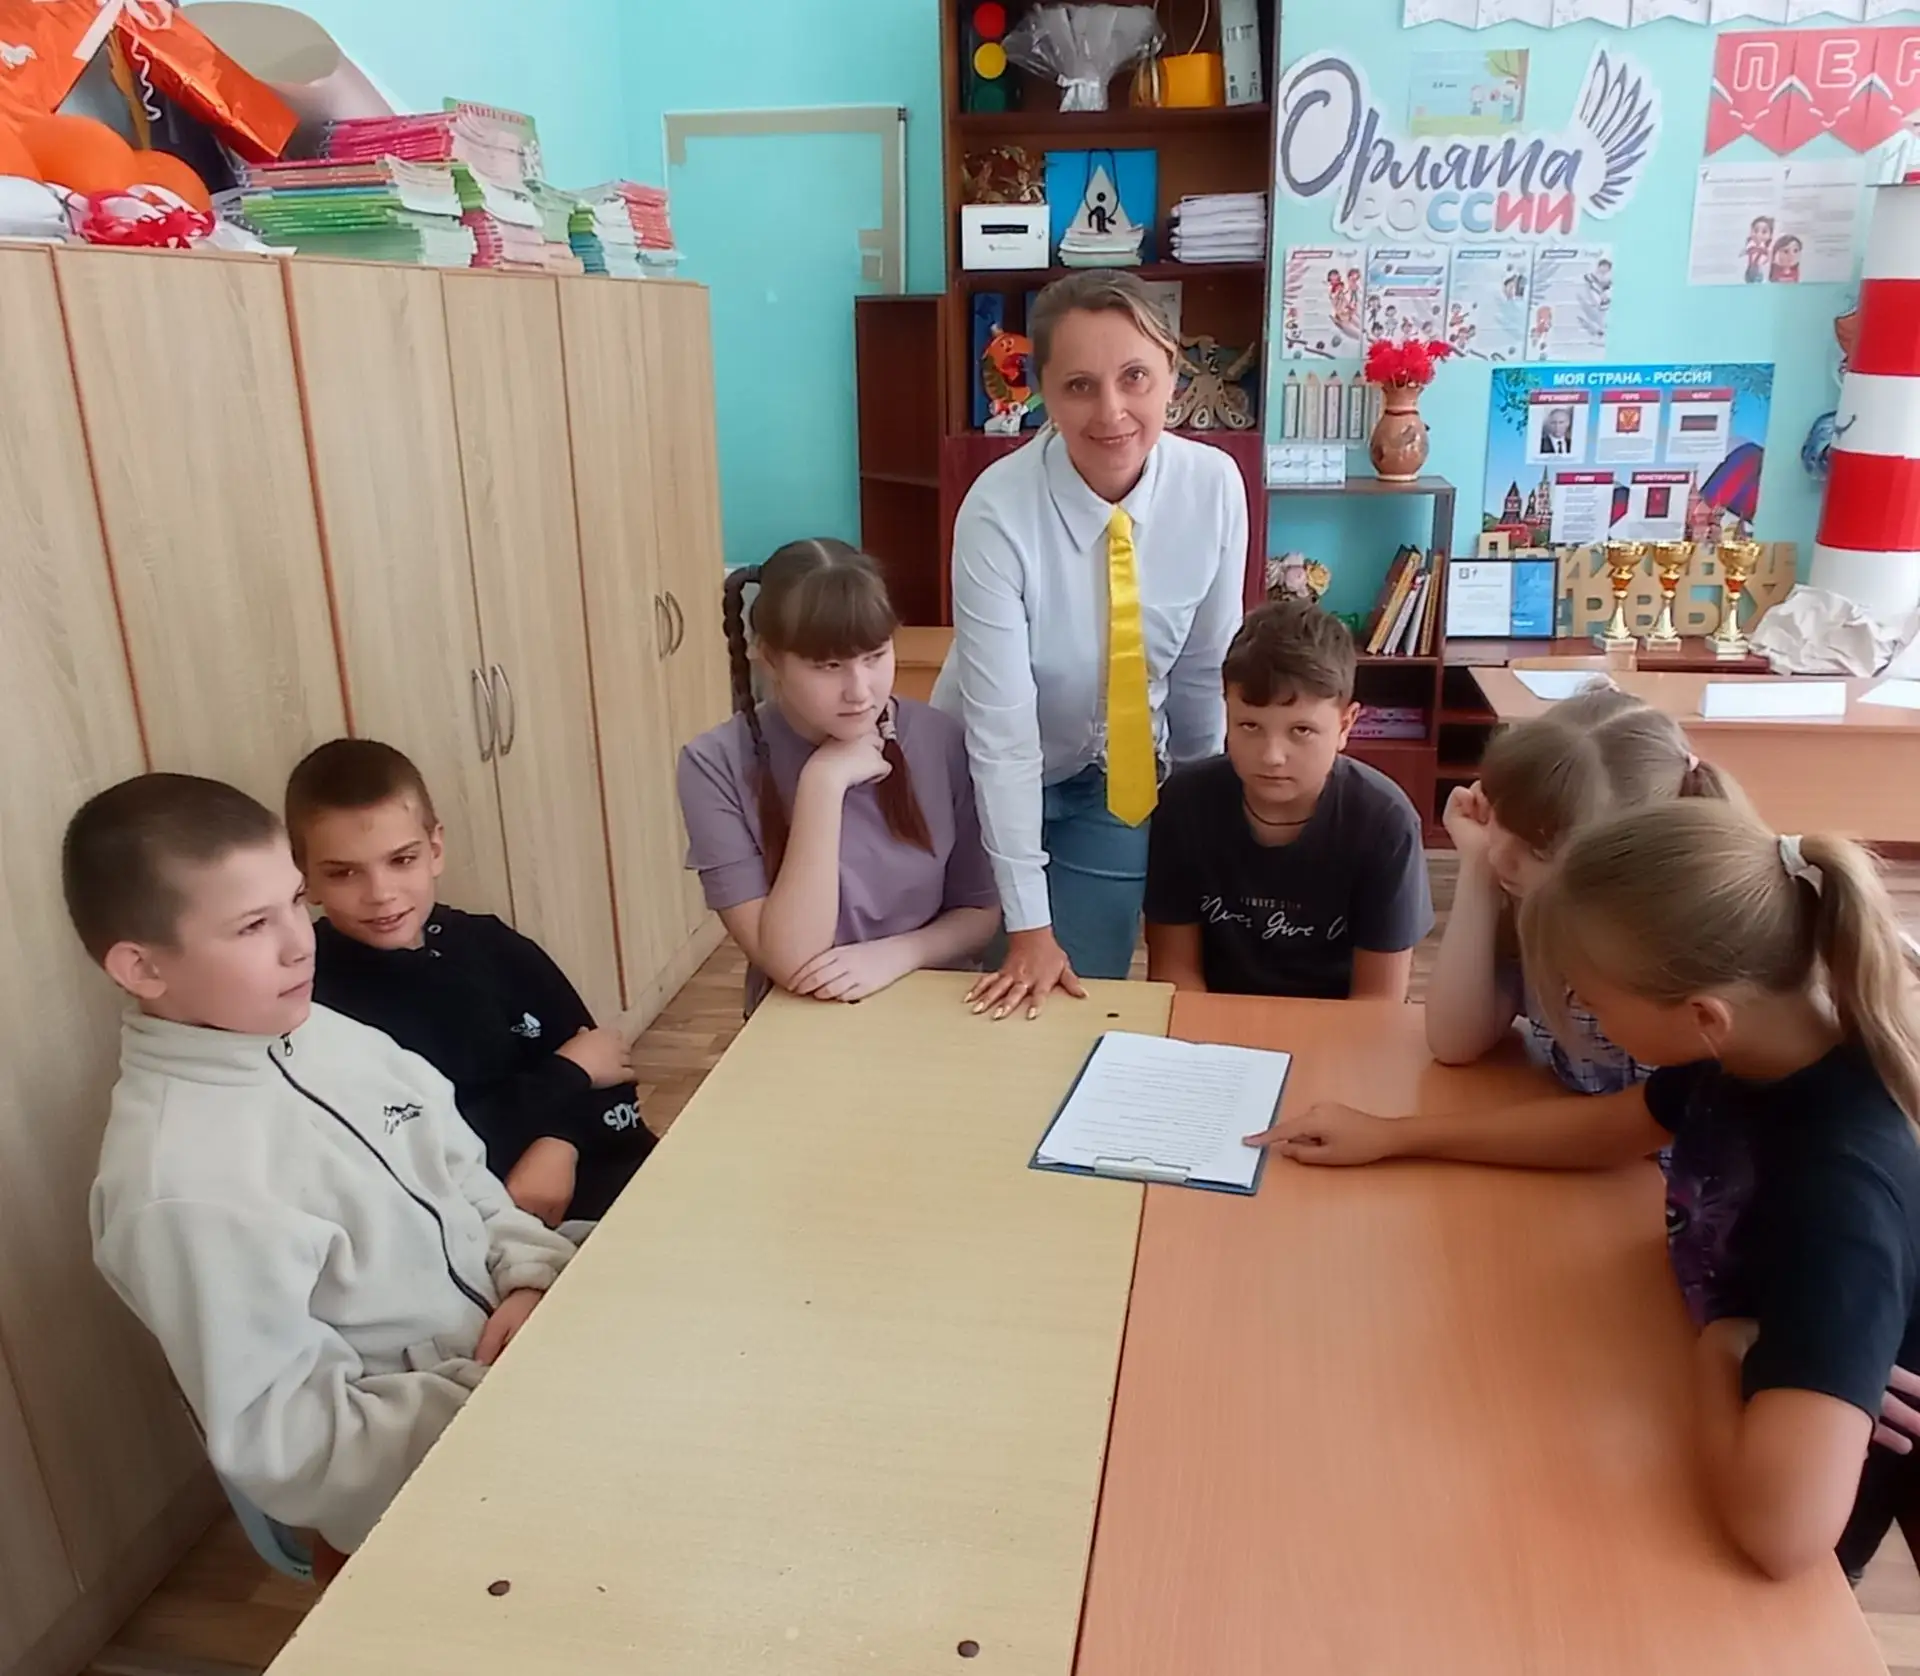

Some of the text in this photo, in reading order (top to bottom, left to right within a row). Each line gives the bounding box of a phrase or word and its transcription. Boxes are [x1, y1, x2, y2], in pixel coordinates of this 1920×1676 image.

[1281, 57, 1583, 224] Орлята
[1353, 190, 1577, 235] РОССИИ
[1552, 372, 1585, 385] МОЯ
[1587, 371, 1642, 385] СТРАНА
[1653, 370, 1713, 384] РОССИЯ
[1261, 910, 1315, 940] Give
